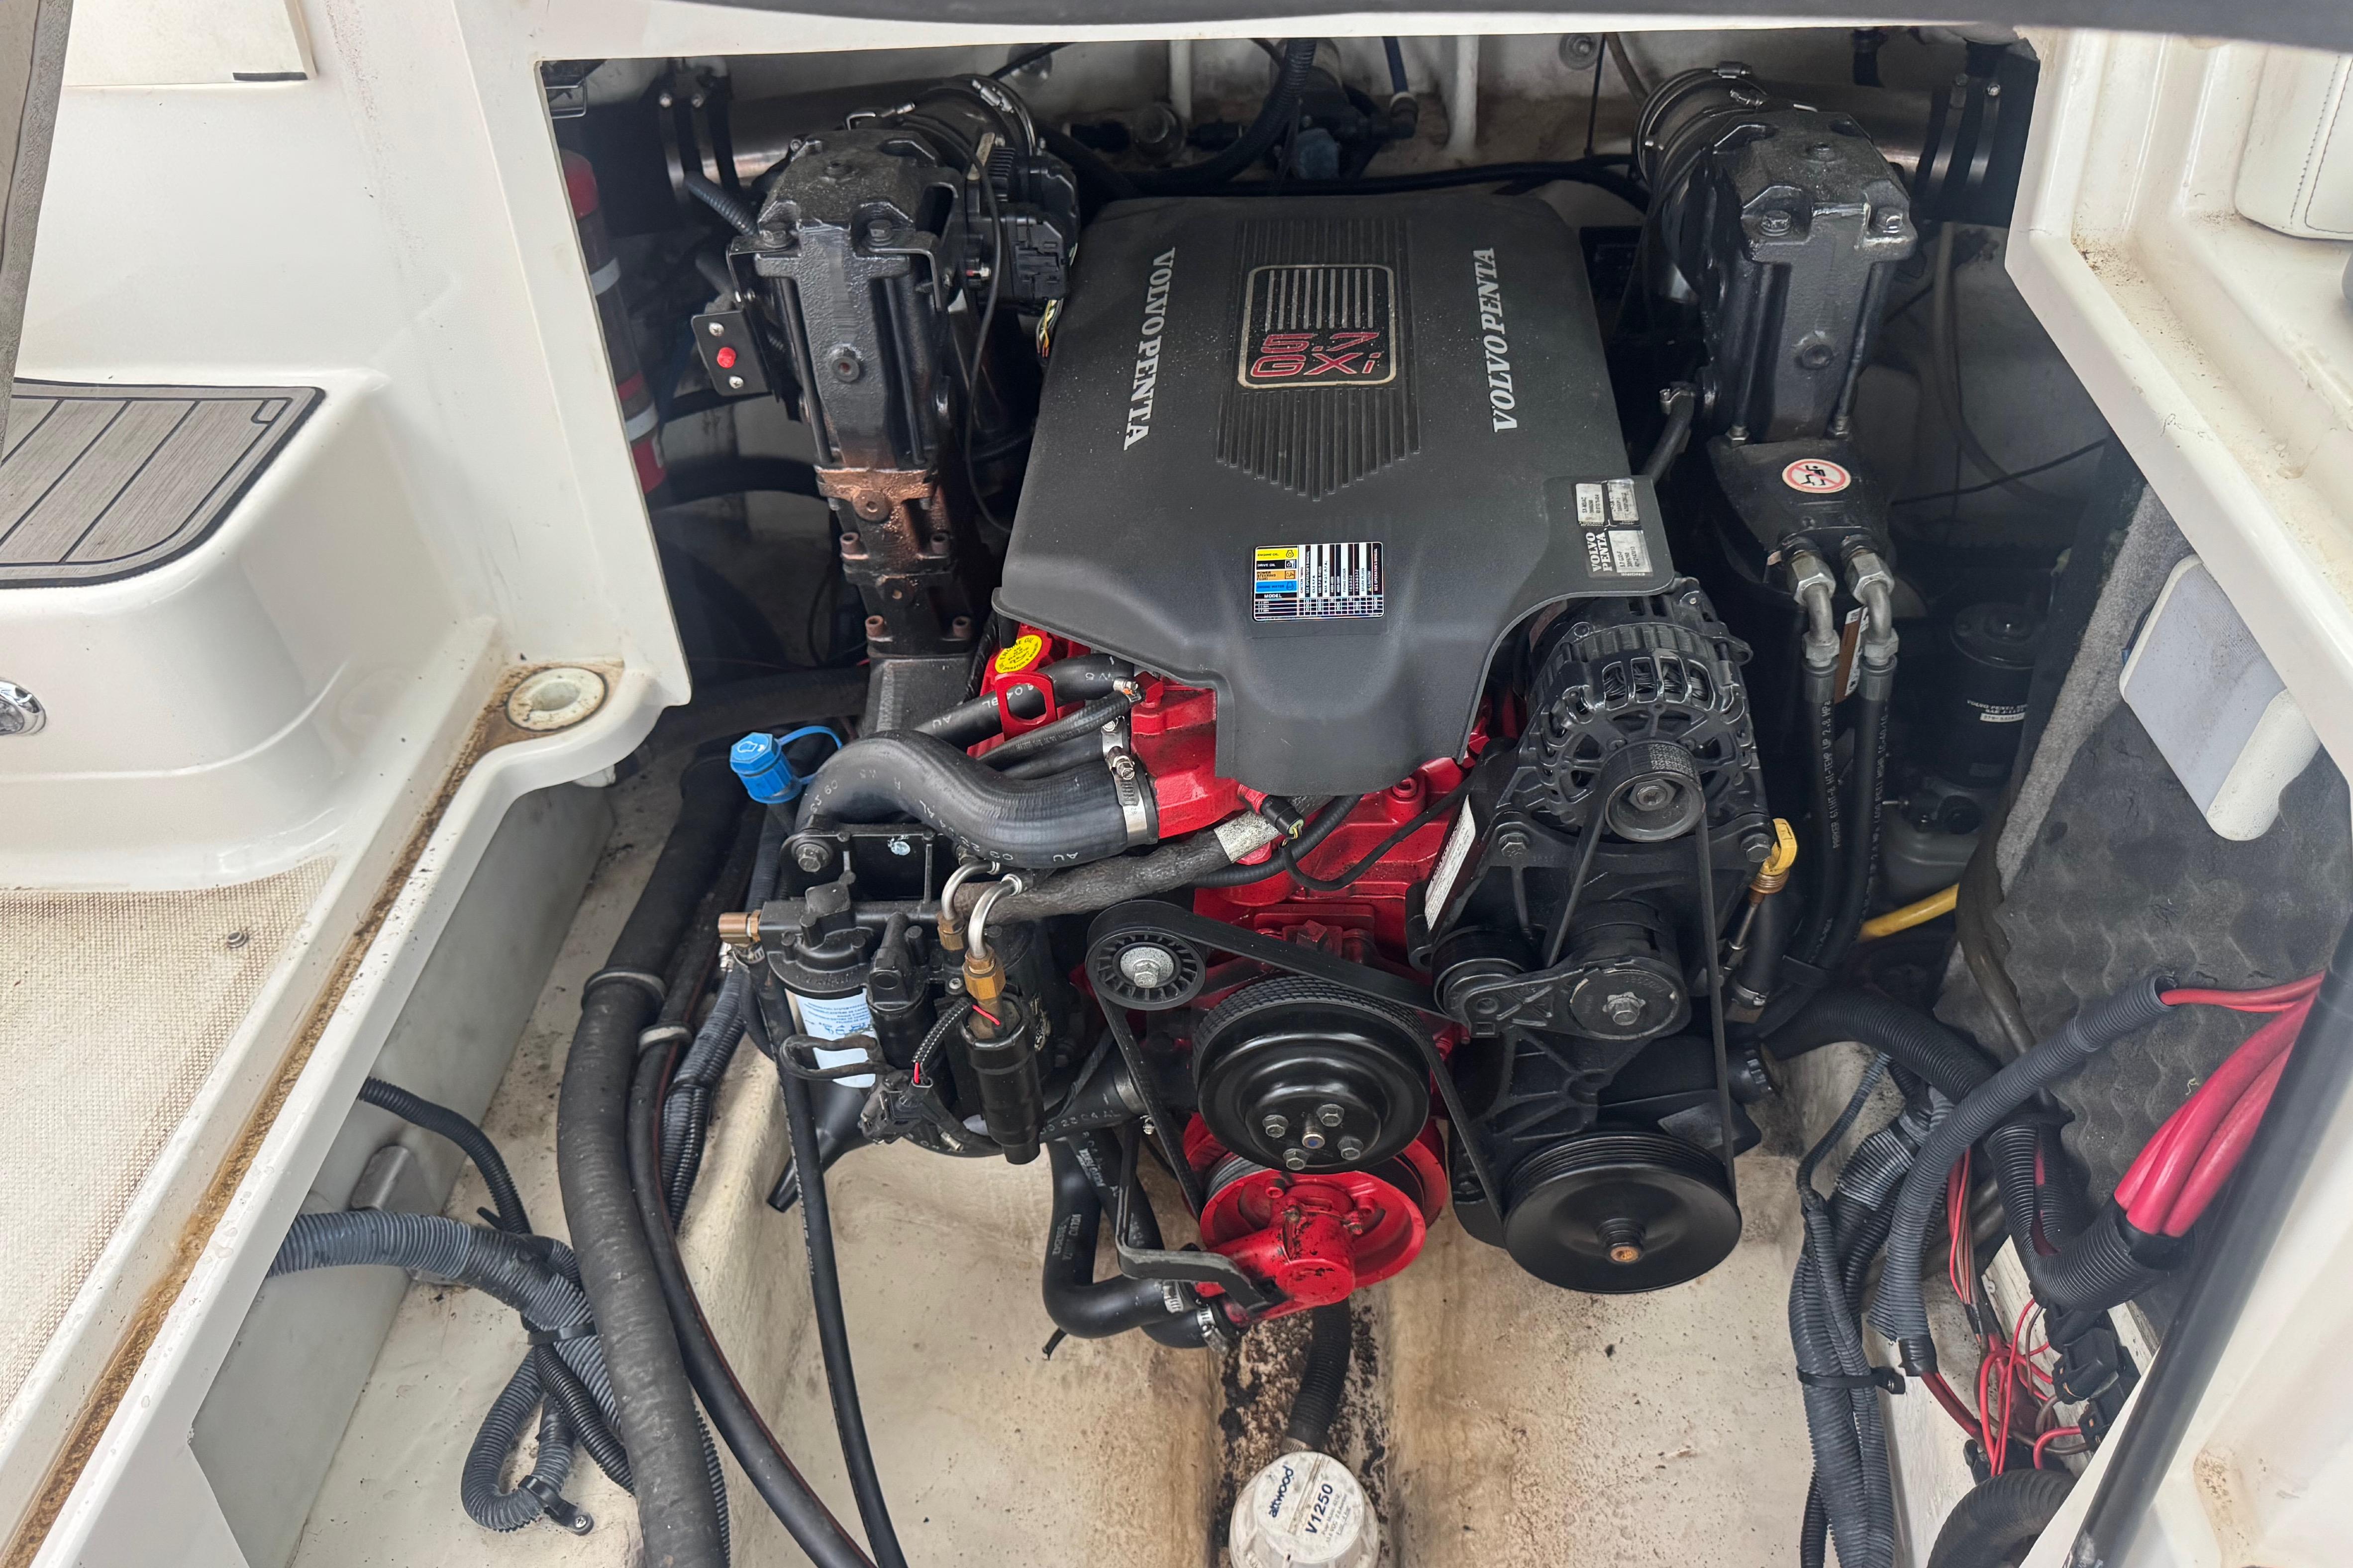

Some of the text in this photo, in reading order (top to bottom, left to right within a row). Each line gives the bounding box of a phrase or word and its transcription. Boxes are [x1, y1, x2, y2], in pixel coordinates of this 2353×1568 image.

[1124, 246, 1176, 451] VOLVO PENTA
[1260, 332, 1380, 352] 5.7
[1473, 247, 1518, 433] VOLVO PENTA
[1250, 352, 1383, 378] GXi
[1586, 532, 1602, 572] VOLVO
[1596, 532, 1613, 572] PENTA
[1000, 640, 1022, 660] ENGNE
[931, 714, 952, 729] AU
[1821, 700, 1831, 717] MPa
[1823, 752, 1835, 785] HI-TEMP
[1831, 821, 1841, 849] PARKER
[1053, 852, 1079, 862] AU
[1268, 1464, 1294, 1518] atwood
[1305, 1483, 1333, 1534] V1250
